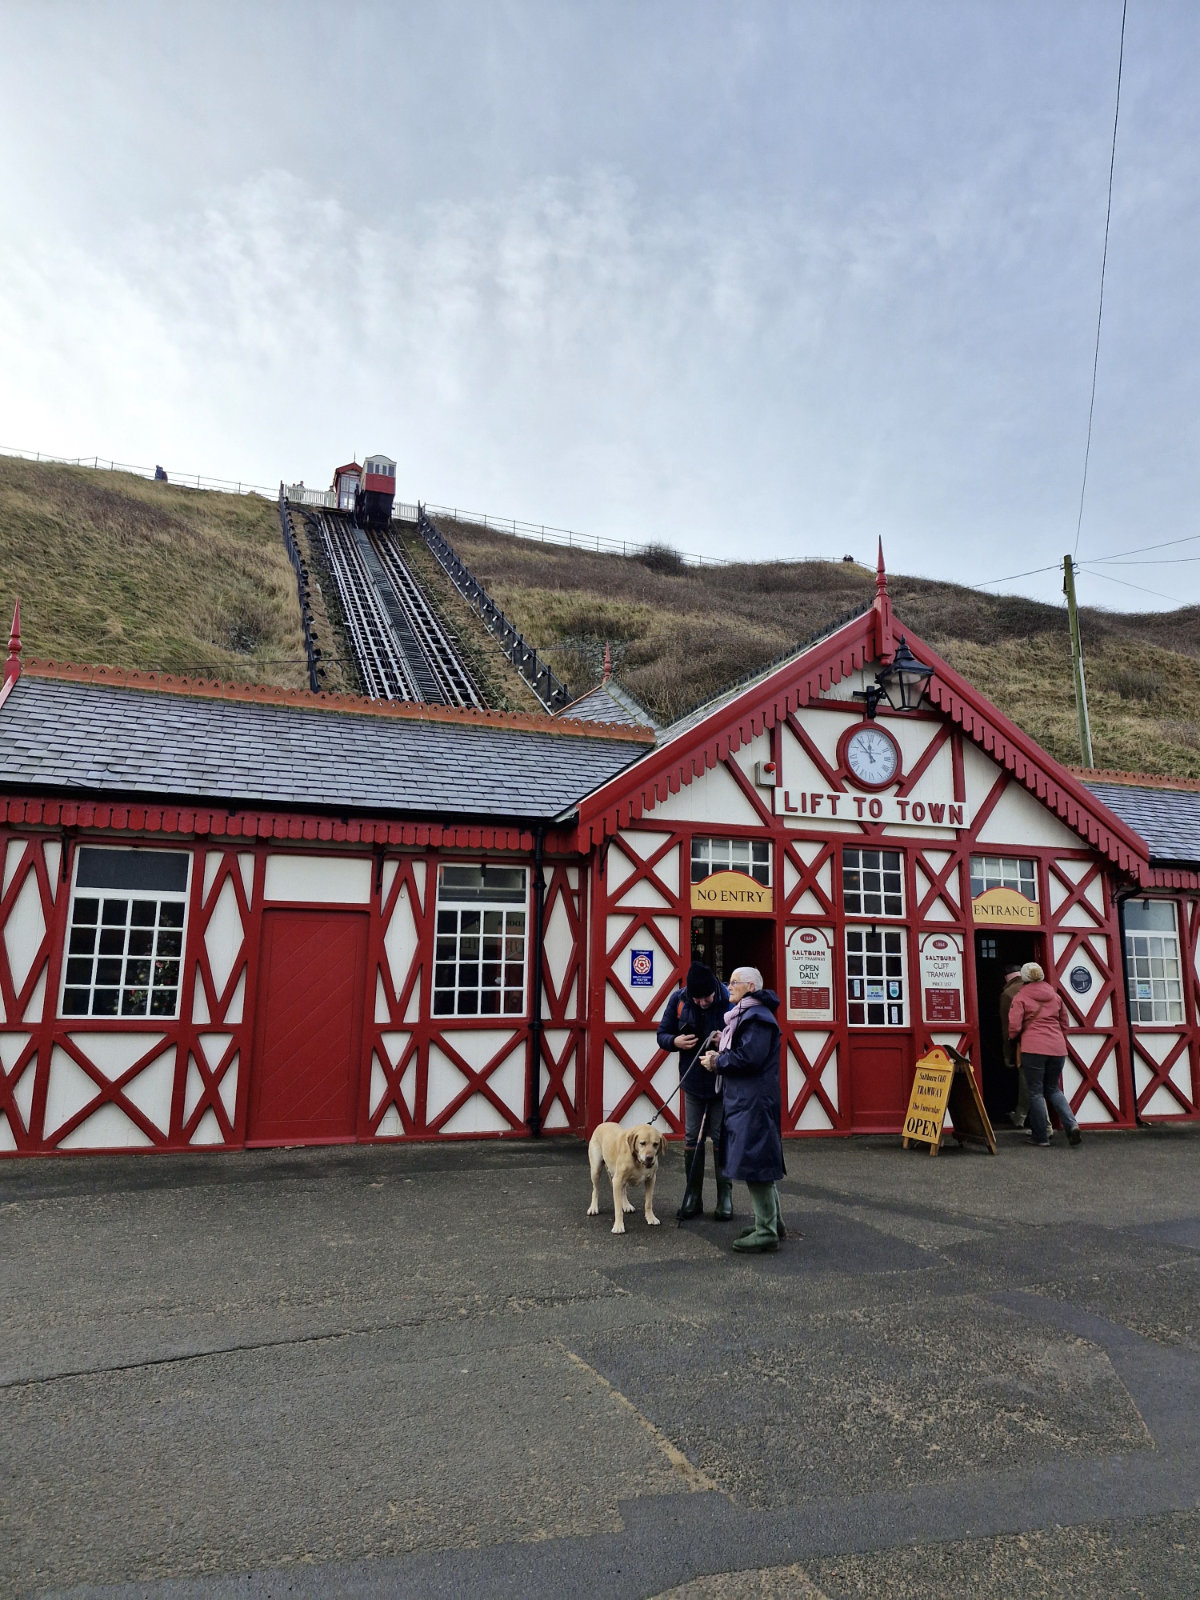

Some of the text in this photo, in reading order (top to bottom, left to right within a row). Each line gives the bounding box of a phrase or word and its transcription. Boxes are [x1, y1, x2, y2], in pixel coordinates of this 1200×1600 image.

[784, 791, 963, 825] LIFT TO TOWN
[697, 889, 765, 903] NO ENTRY
[974, 904, 1035, 918] ENTRANCE
[799, 964, 819, 972] OPEN
[933, 962, 949, 970] CLIFF
[799, 971, 820, 980] DAILY
[917, 1085, 942, 1098] TRAMWAY
[907, 1116, 941, 1139] OPEN
